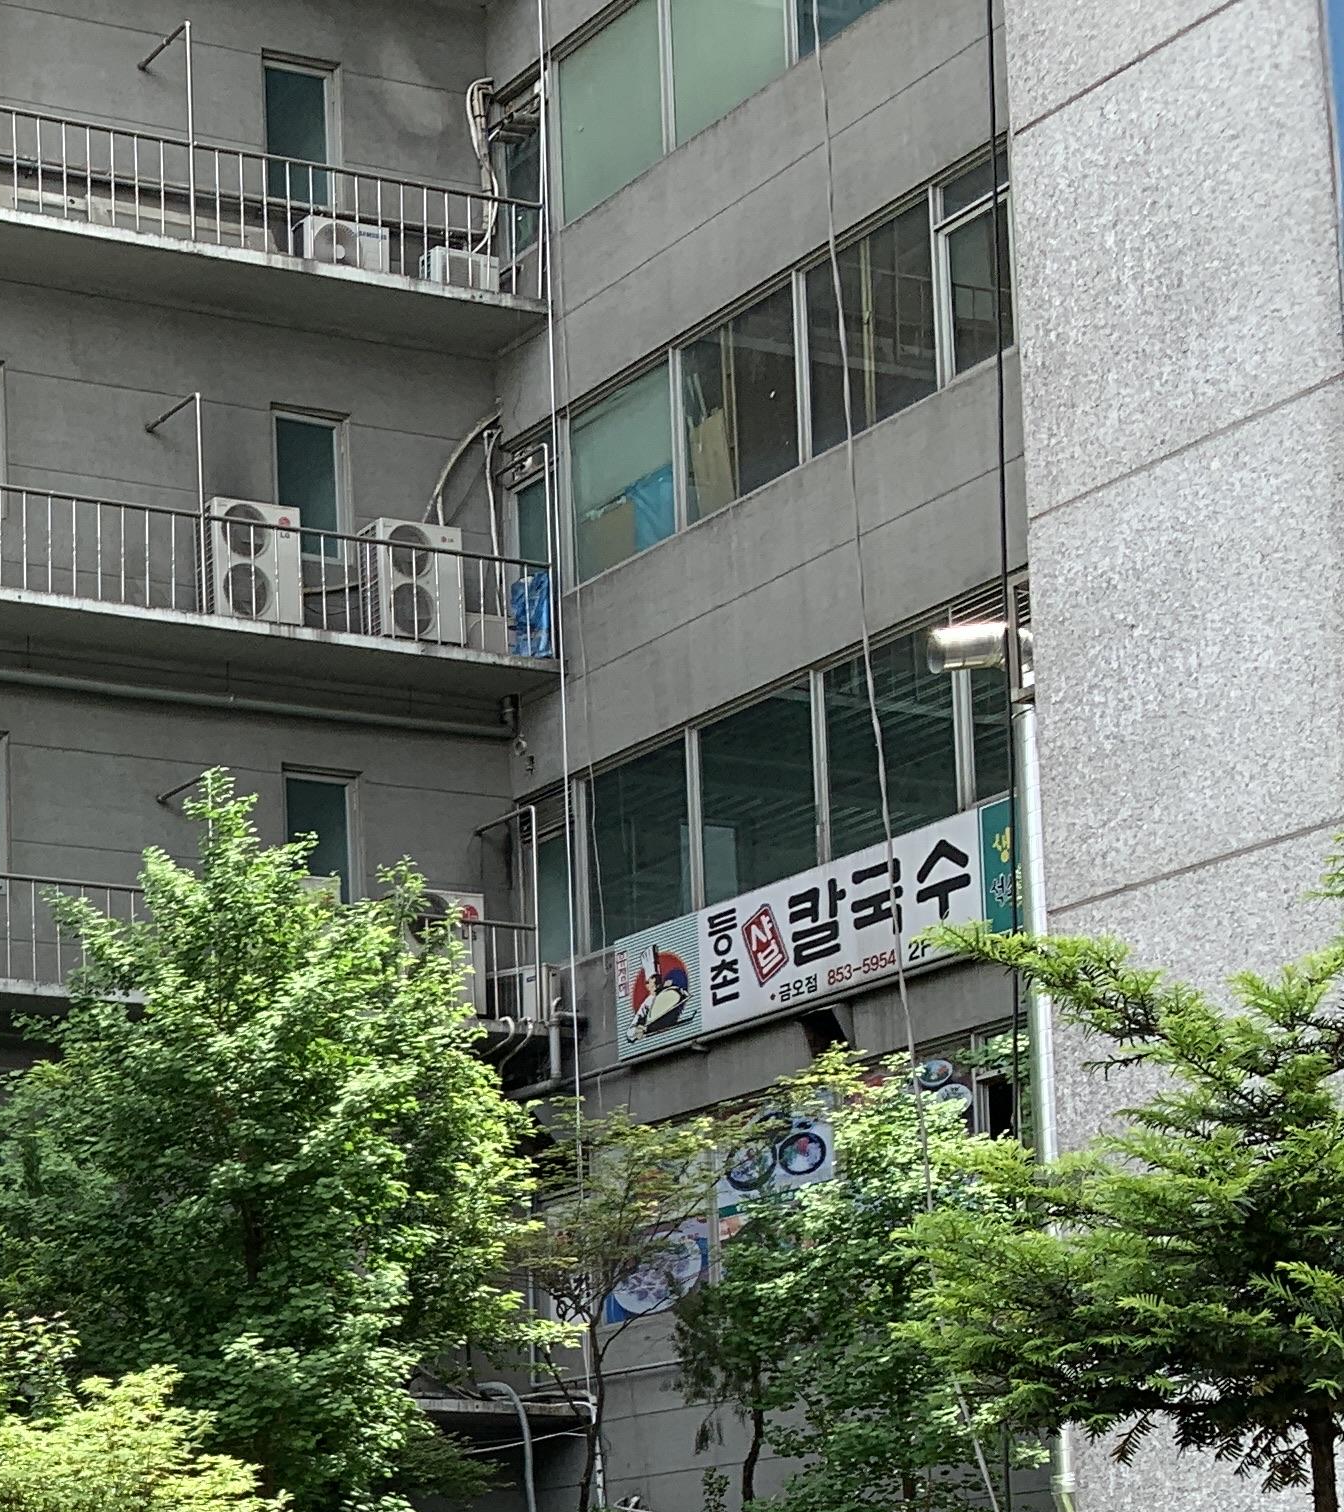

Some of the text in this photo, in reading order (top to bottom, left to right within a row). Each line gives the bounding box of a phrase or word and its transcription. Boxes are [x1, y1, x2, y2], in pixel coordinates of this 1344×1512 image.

[788, 839, 971, 967] 칼국수
[708, 908, 740, 1006] 등촌
[779, 949, 897, 1002] 금오점 853-5954
